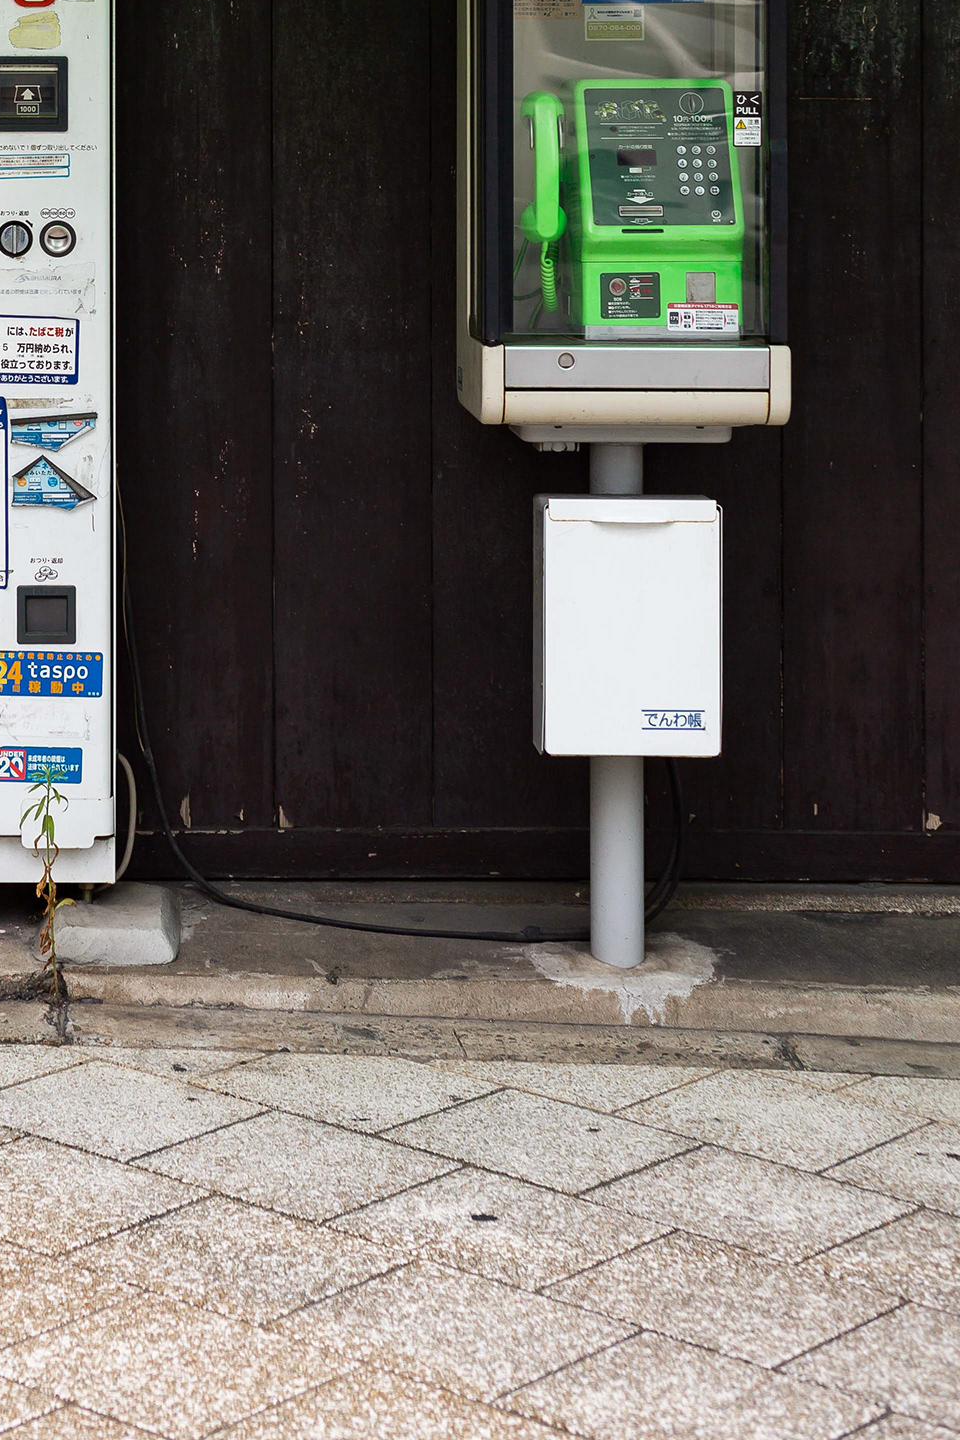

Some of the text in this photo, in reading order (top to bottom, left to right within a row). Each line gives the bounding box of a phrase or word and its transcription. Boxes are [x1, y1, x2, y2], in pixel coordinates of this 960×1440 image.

[736, 94, 760, 105] ひく
[736, 107, 759, 115] PULL
[7, 326, 74, 337] には、たばこ税が
[16, 343, 73, 354] 万円納められ、
[27, 661, 89, 683] taspo
[644, 713, 702, 728] でんわ帳
